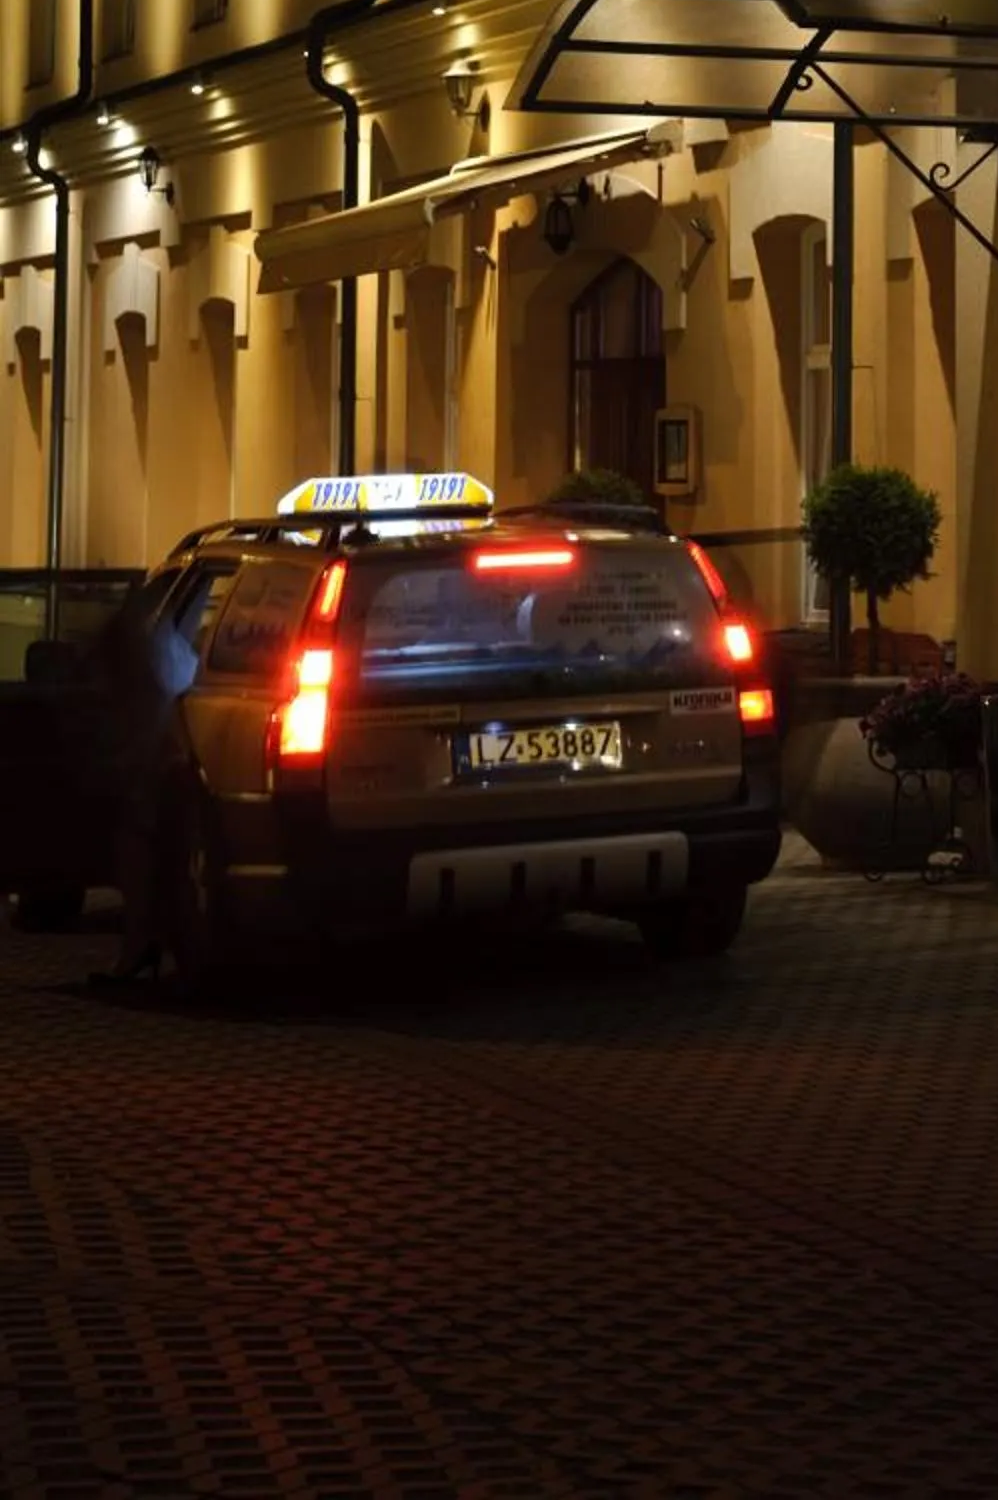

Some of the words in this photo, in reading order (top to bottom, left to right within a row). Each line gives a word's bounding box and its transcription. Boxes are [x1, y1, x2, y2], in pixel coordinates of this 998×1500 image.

[313, 482, 361, 507] 19191
[419, 476, 467, 501] 19191
[477, 733, 516, 763] LZ
[526, 728, 612, 759] 53887
